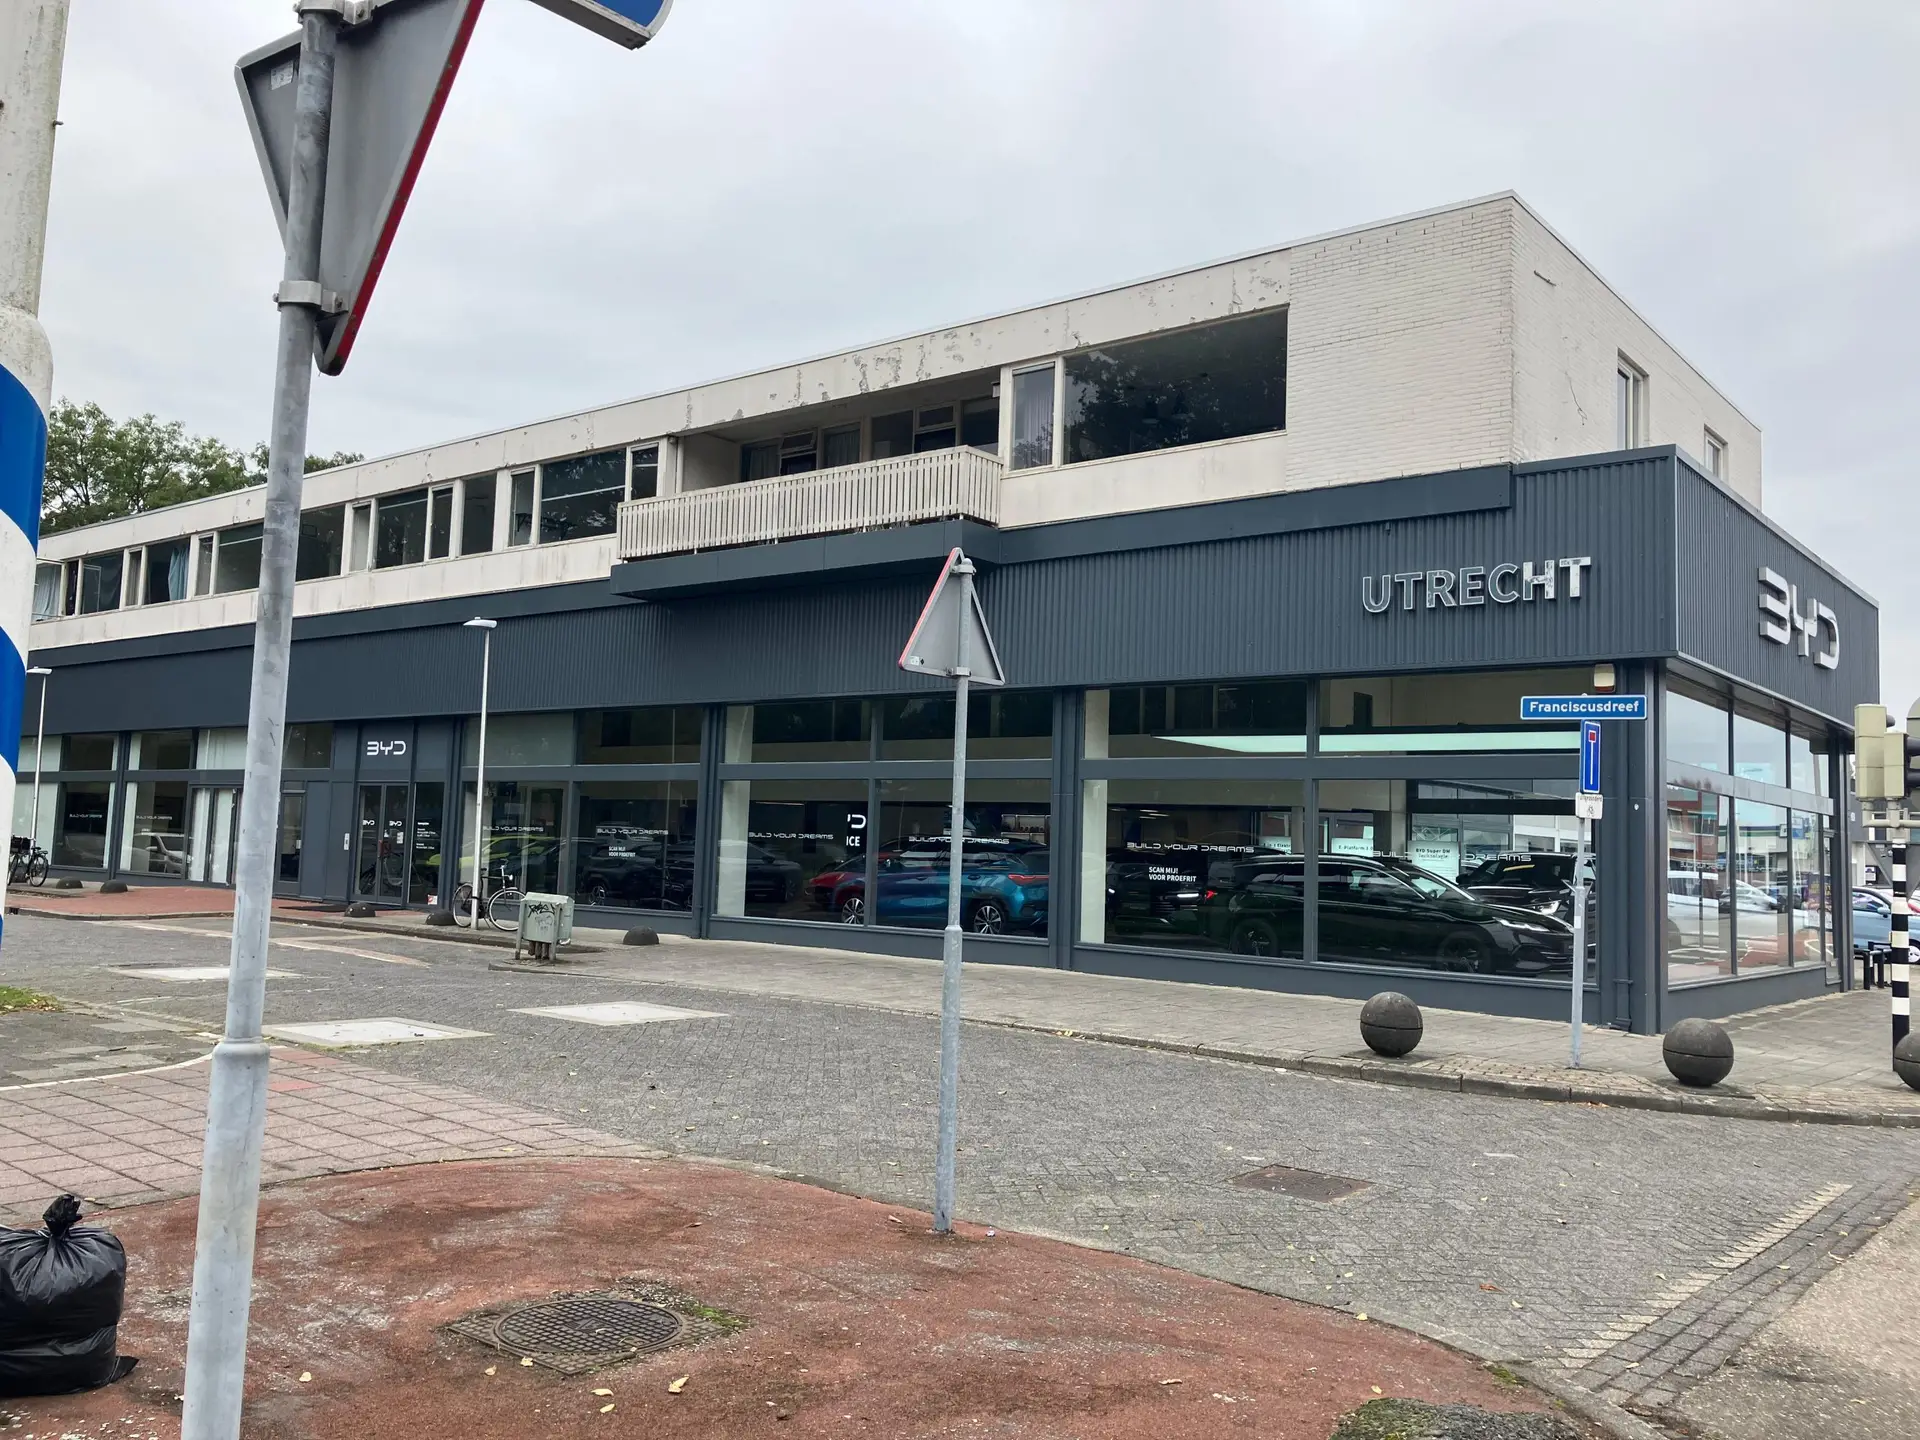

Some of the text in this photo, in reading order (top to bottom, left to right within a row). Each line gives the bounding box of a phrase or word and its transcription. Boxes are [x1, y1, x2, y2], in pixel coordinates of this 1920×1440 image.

[1362, 556, 1593, 613] UTRECHT
[1758, 566, 1840, 670] BYD
[1529, 700, 1640, 713] Franciscusdreef
[366, 740, 407, 756] BYD
[1126, 841, 1162, 849] BUILD
[1163, 843, 1198, 851] YOUR
[1200, 845, 1255, 854] DREAMS
[1465, 853, 1532, 862] DREAMS
[1166, 874, 1197, 882] PROEFRIT
